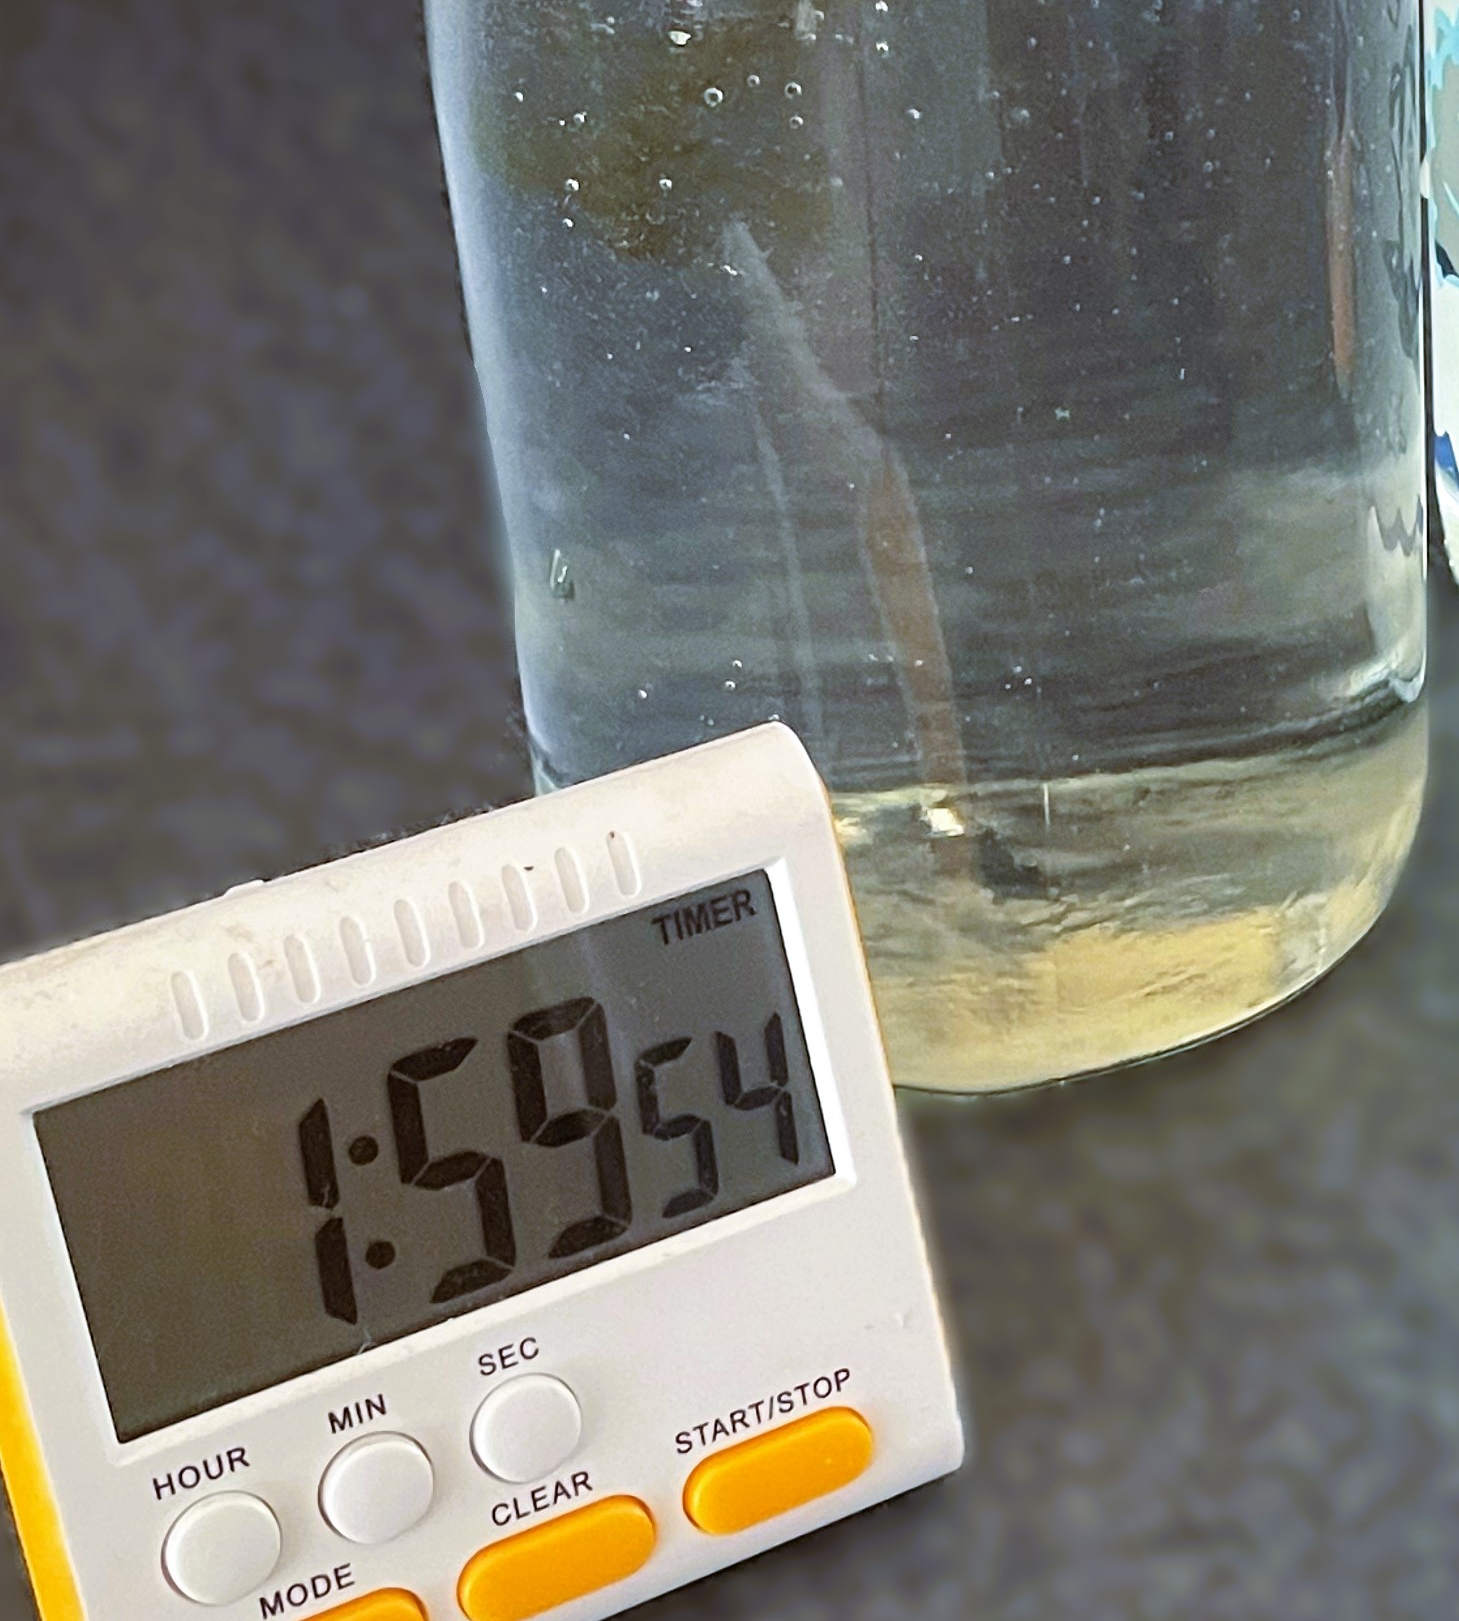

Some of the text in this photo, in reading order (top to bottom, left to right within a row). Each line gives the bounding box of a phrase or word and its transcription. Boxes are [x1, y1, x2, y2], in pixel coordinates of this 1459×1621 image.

[652, 889, 757, 947] TIMER
[477, 1336, 541, 1377] SEC
[327, 1393, 388, 1434] MIN
[674, 1367, 852, 1456] START/STOP
[152, 1446, 251, 1501] HOUR
[490, 1470, 594, 1528] CLEAR
[259, 1562, 356, 1620] MODE
